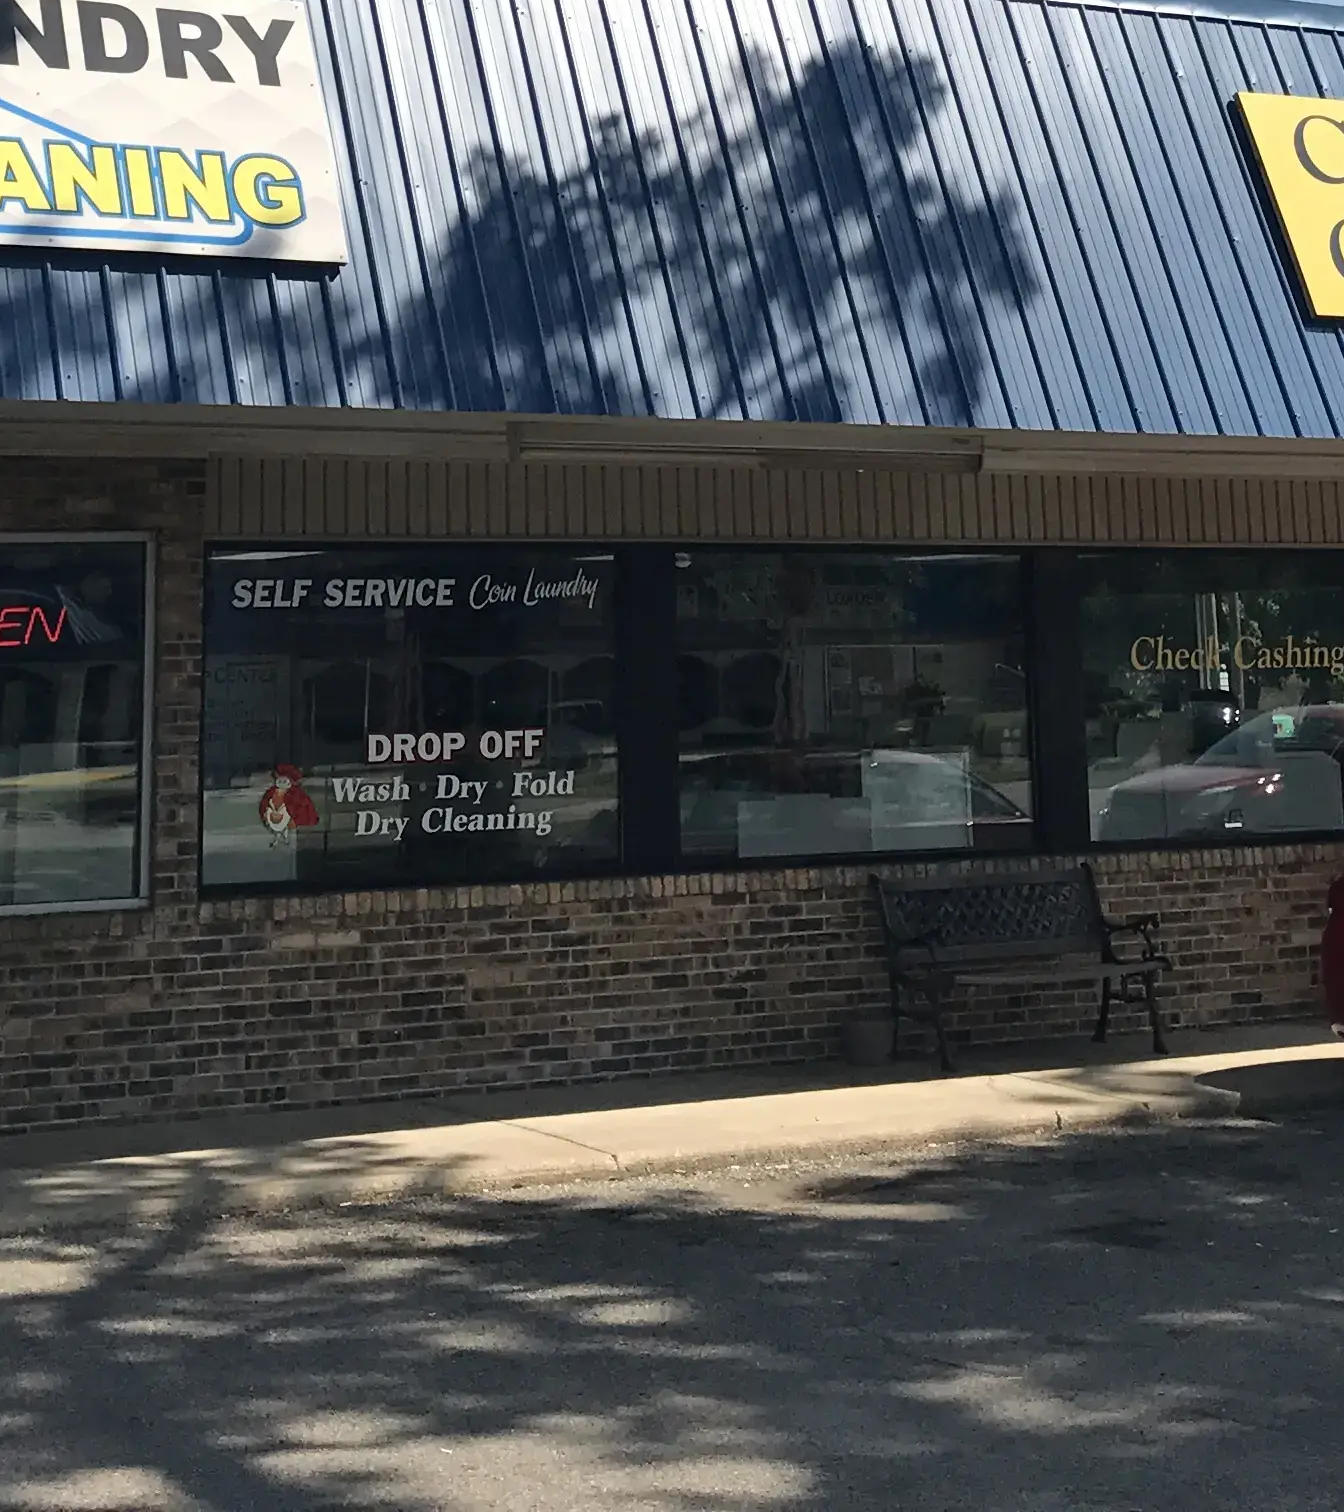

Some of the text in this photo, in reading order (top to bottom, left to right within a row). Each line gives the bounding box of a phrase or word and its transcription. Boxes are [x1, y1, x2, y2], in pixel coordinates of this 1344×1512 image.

[231, 567, 600, 610] SELF SERVICE Coin Laundry
[1130, 635, 1223, 672] Check
[366, 727, 544, 764] DROP OFF
[331, 770, 576, 805] Wash Dry Fold
[355, 804, 554, 841] Dry Cleaning
